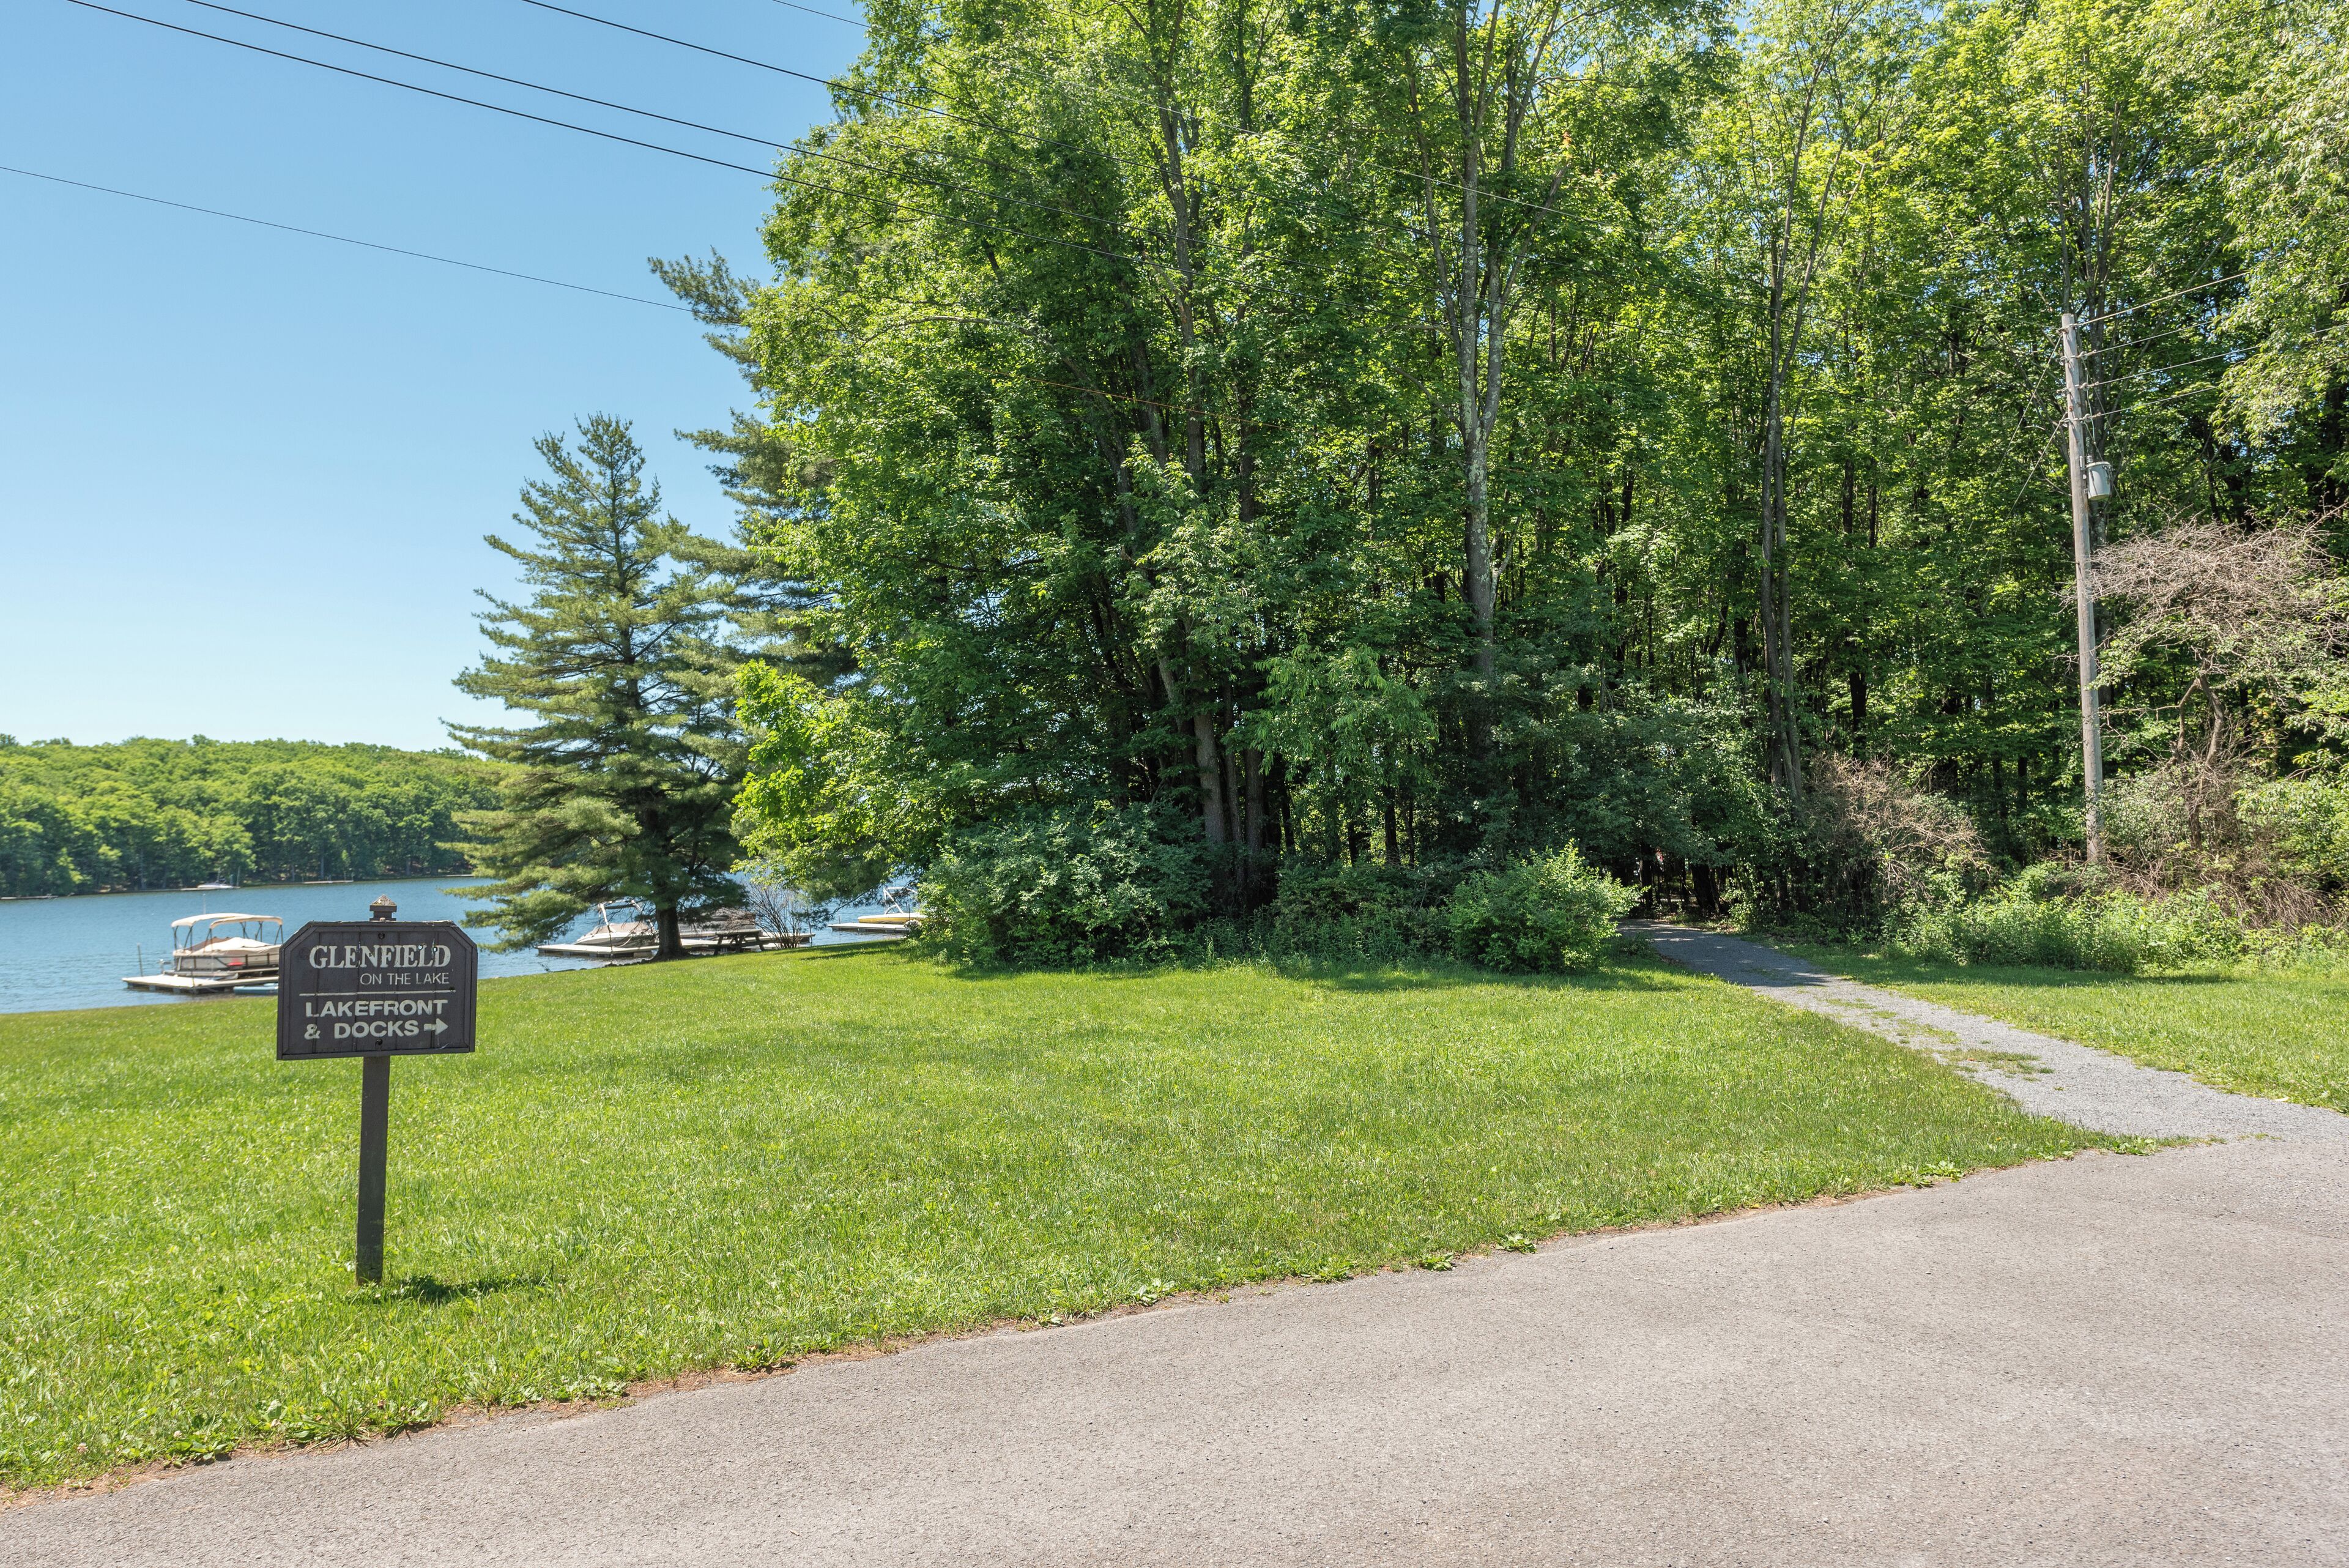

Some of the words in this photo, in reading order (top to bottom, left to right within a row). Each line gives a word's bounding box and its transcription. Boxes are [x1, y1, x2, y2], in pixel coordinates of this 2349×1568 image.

[309, 944, 451, 969] GLENFIELD
[360, 973, 382, 985] ON
[387, 973, 412, 985] THE
[415, 972, 450, 984] LAKE
[305, 999, 448, 1017] LAKEFRONT
[303, 1024, 321, 1039] &
[334, 1020, 419, 1039] DOCKS
